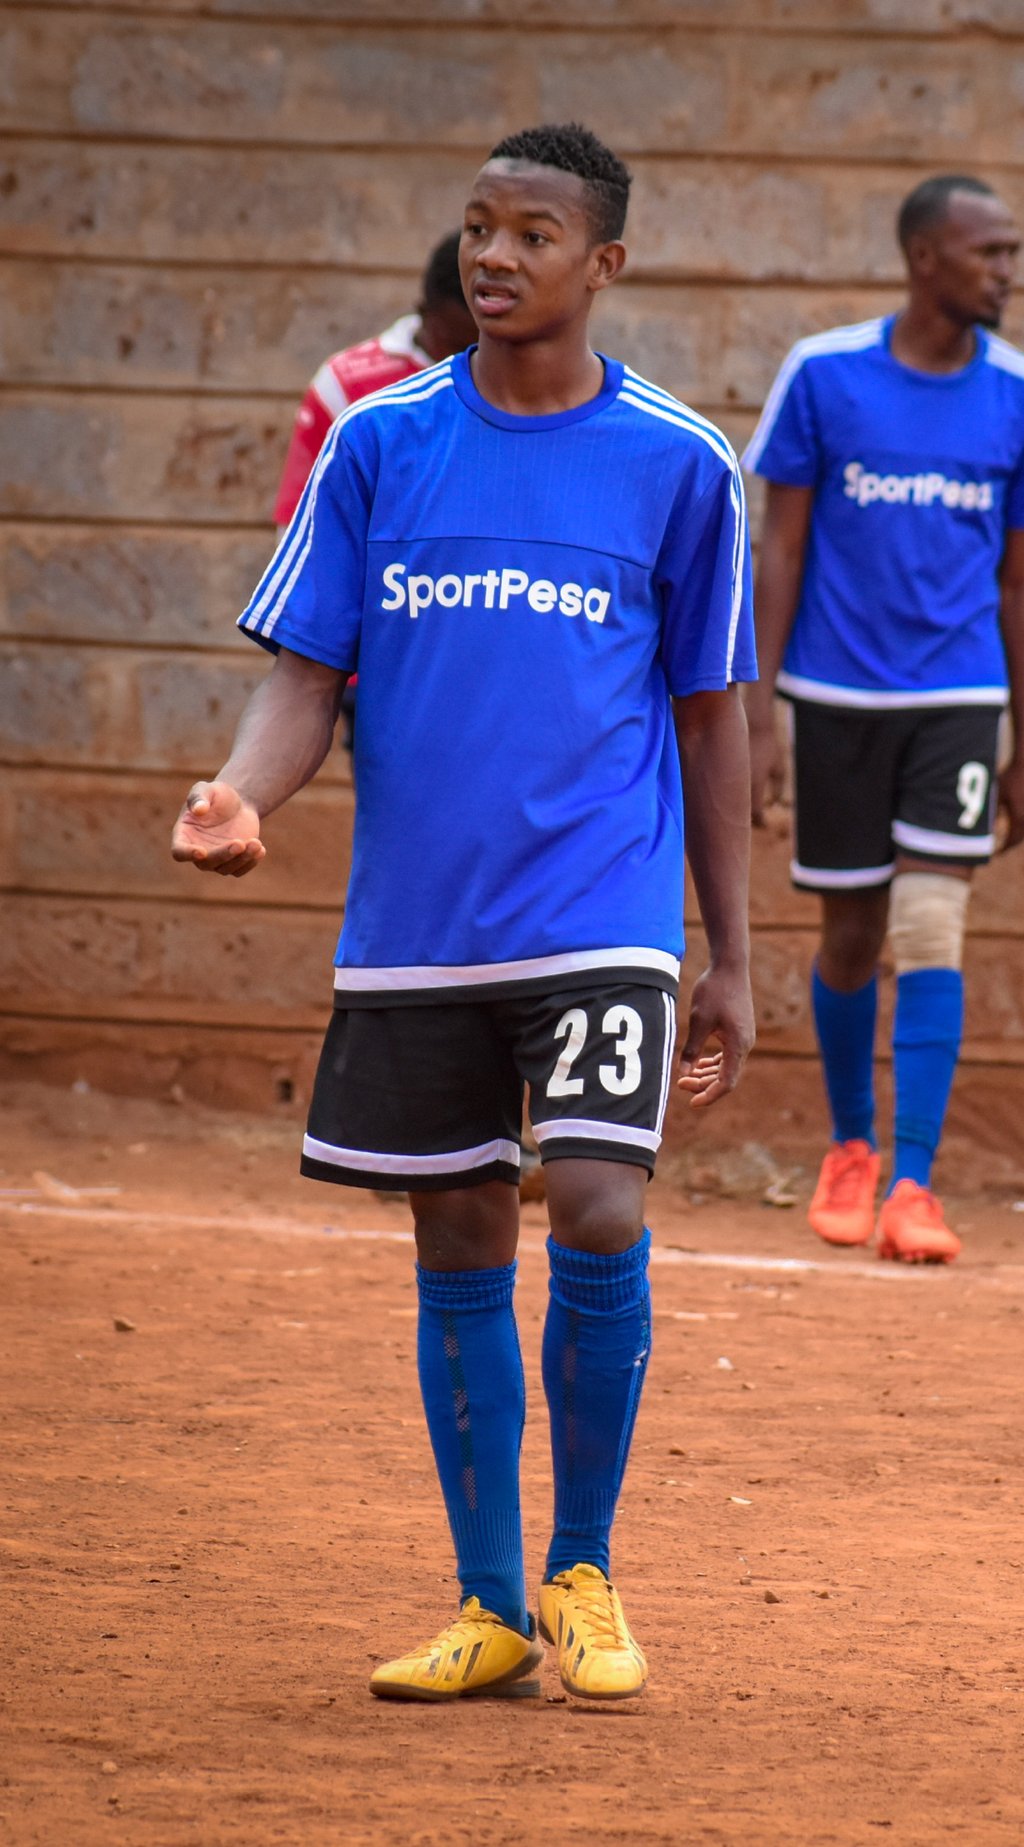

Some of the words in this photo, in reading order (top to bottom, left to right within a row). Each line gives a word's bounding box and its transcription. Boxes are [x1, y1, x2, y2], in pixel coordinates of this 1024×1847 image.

[843, 462, 994, 510] SportPesa
[381, 562, 612, 624] SportPesa
[957, 762, 988, 829] 9
[545, 1004, 644, 1098] 23
